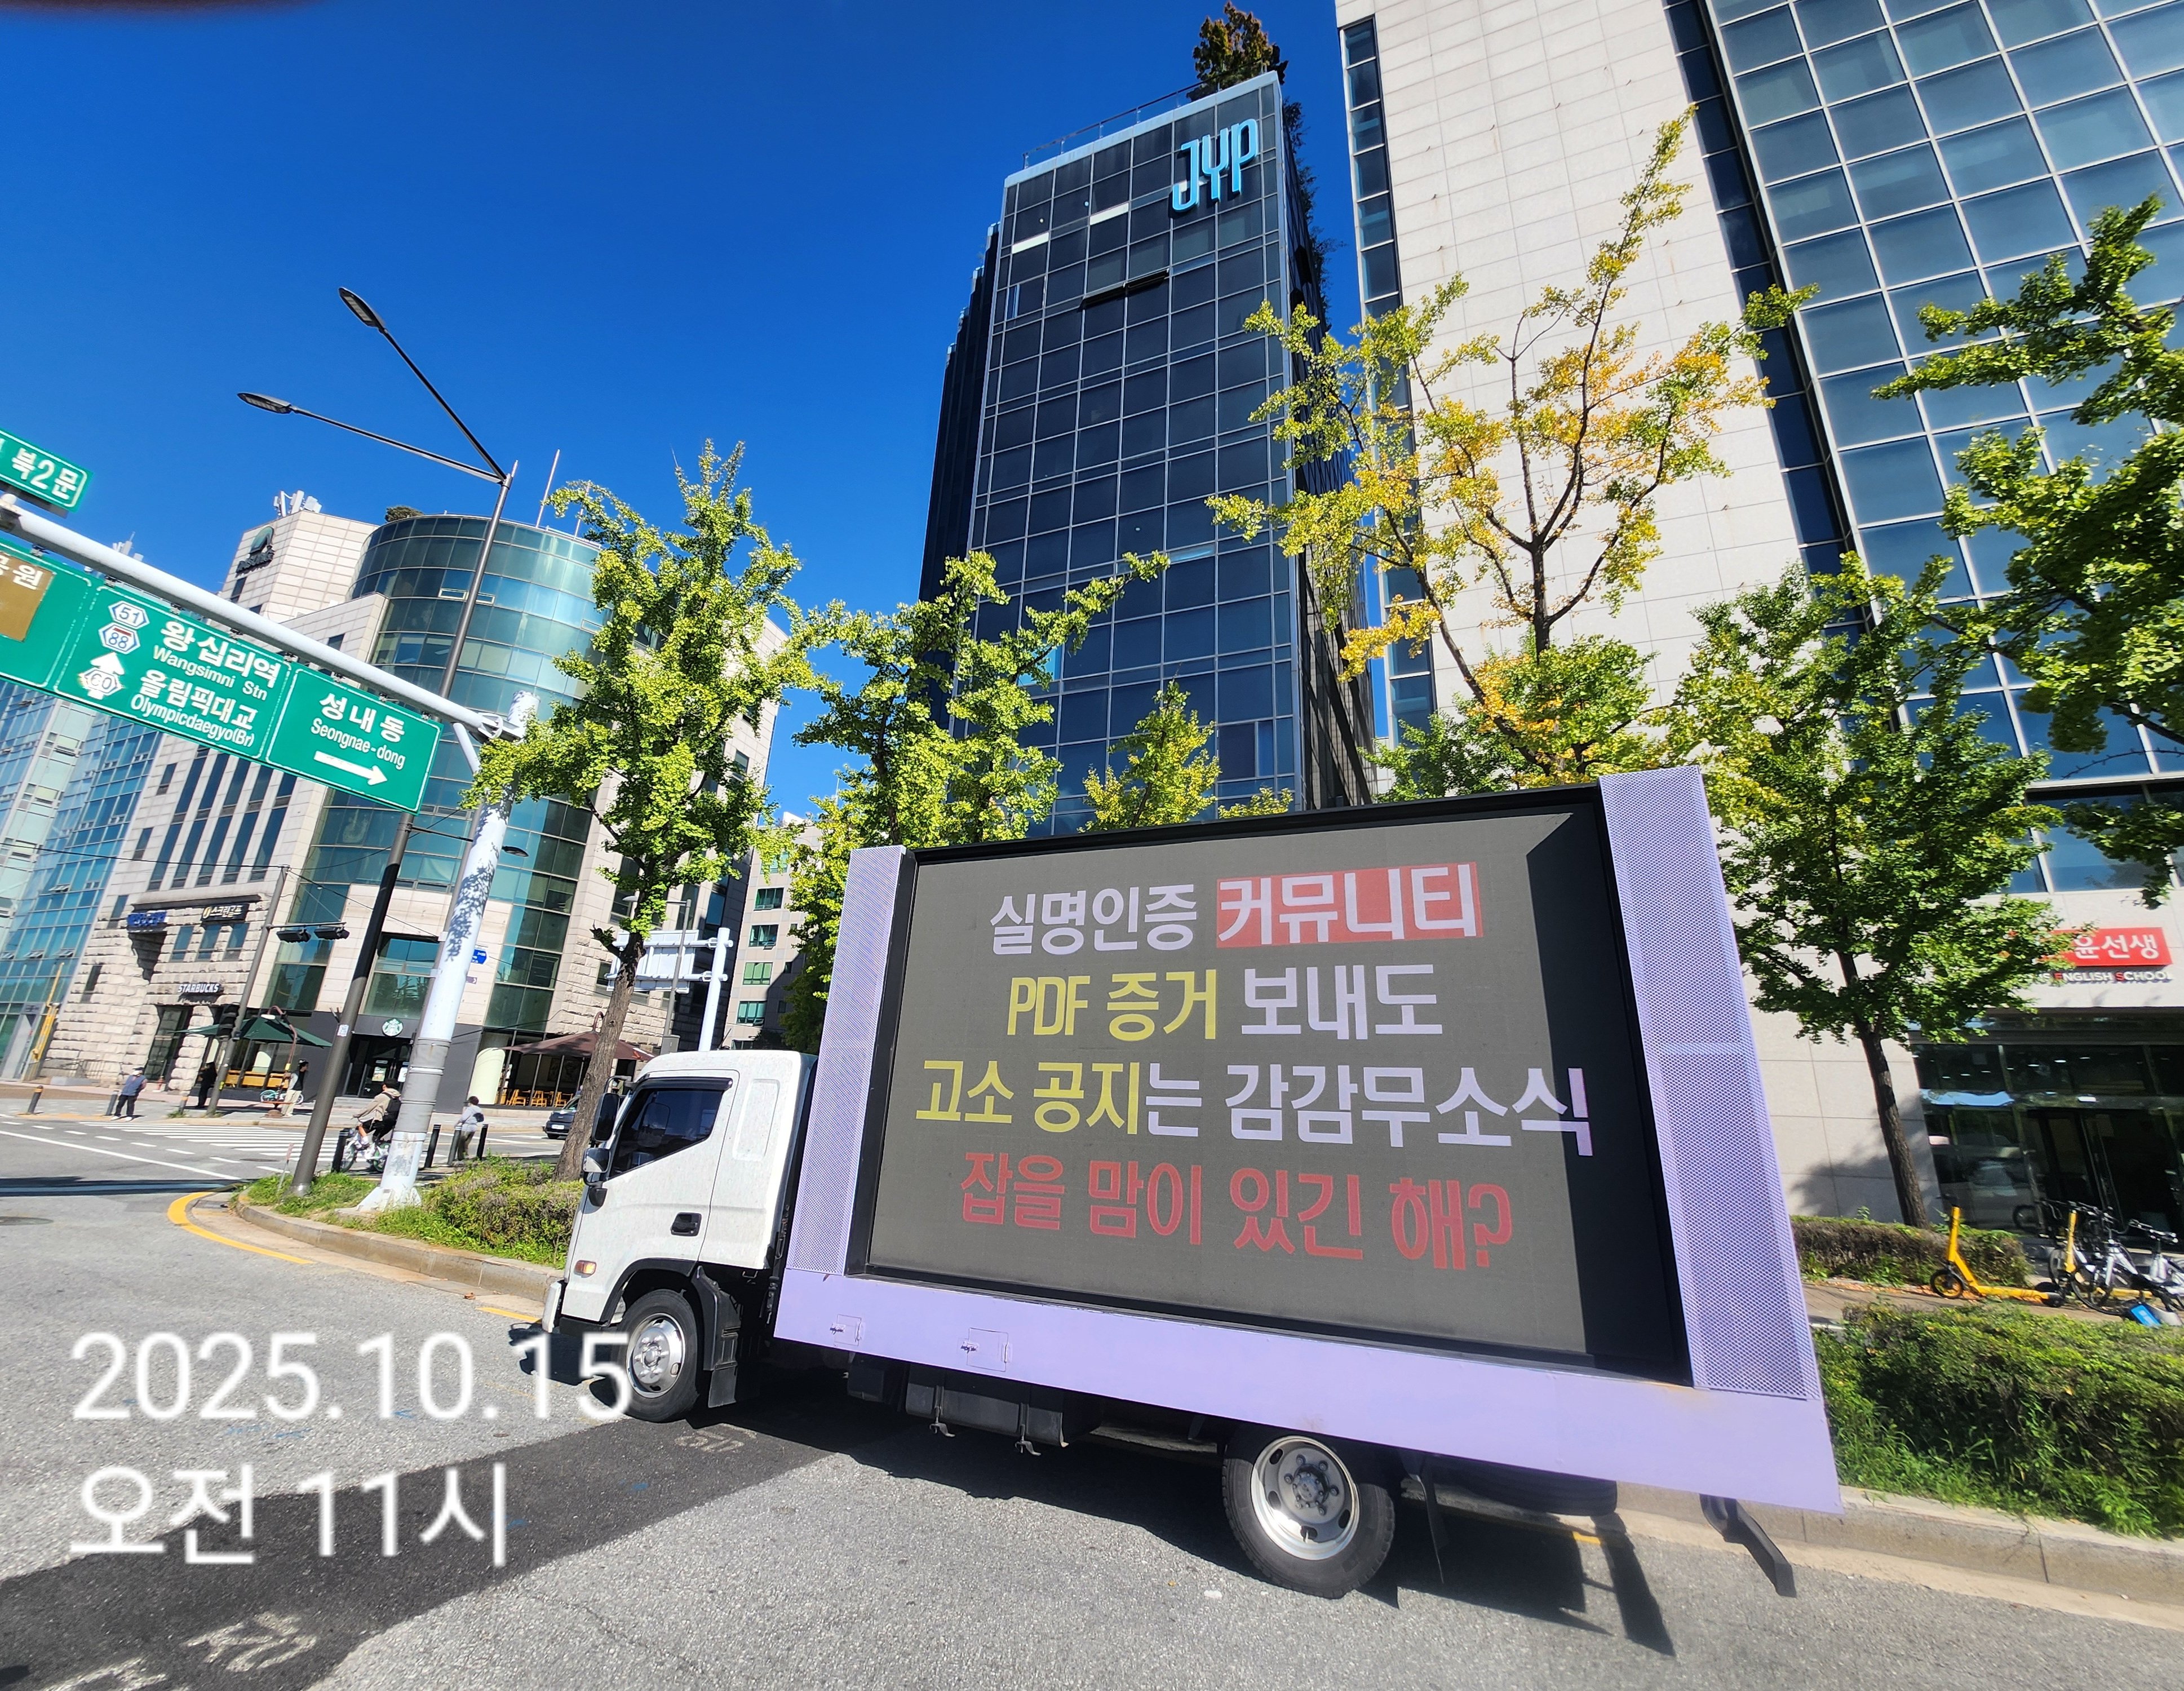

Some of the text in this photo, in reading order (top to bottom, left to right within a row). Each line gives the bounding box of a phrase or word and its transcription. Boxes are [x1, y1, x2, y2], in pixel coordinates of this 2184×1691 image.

[1172, 119, 1258, 211] JYP
[12, 448, 78, 500] 북2문
[108, 634, 129, 649] 88
[118, 607, 140, 624] 51
[153, 645, 268, 701] Wangsimni Stn
[161, 621, 281, 688] 왕십리역
[130, 693, 255, 747] Olympicdaegyo(Br)
[140, 669, 258, 731] 올림픽대교
[319, 692, 405, 743] 성내동
[311, 718, 406, 771] Seongnae-dong
[990, 864, 1477, 956] 실명인증 커뮤니티
[2074, 933, 2160, 959] 윤선생
[178, 984, 220, 994] STARBUCKS
[1007, 964, 1444, 1042] PDF 증거 보내도
[2054, 971, 2113, 981] ENGLISH
[2115, 971, 2173, 981] SCHOOL
[915, 1060, 1593, 1157] 고소 공지는 감감무소식
[960, 1152, 1513, 1270] 잡을 맘이 있긴 해?
